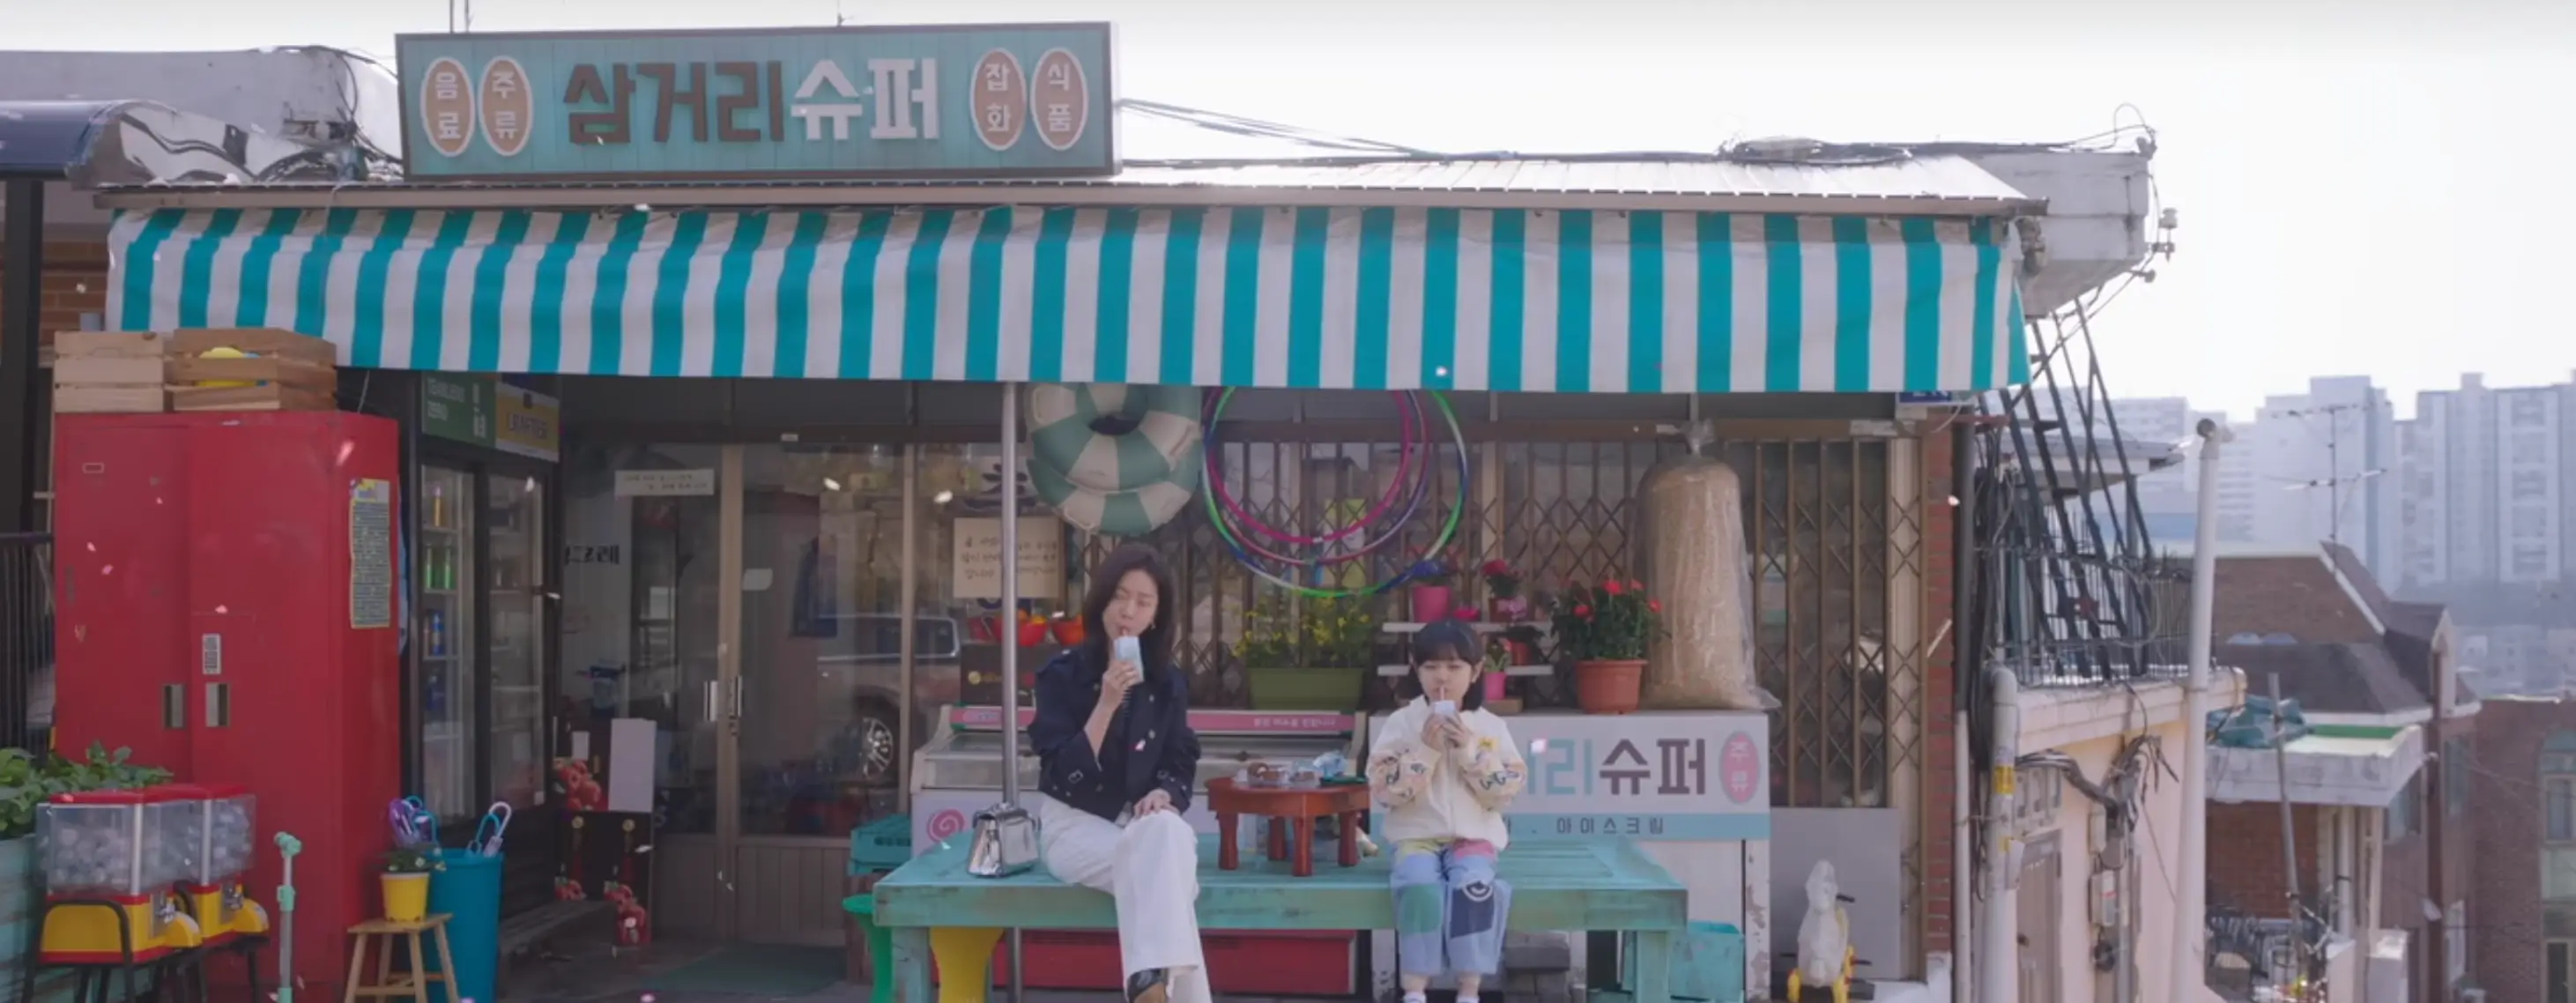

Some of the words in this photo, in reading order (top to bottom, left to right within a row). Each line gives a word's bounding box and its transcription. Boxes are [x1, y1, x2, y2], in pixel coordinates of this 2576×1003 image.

[434, 71, 461, 139] 음료
[490, 71, 518, 139] 주류
[562, 57, 939, 145] 삼거리슈퍼
[984, 62, 1011, 132] 잡화
[1046, 62, 1073, 132] 식품
[1730, 740, 1749, 792] 주류
[1556, 816, 1664, 835] 아이스크림
